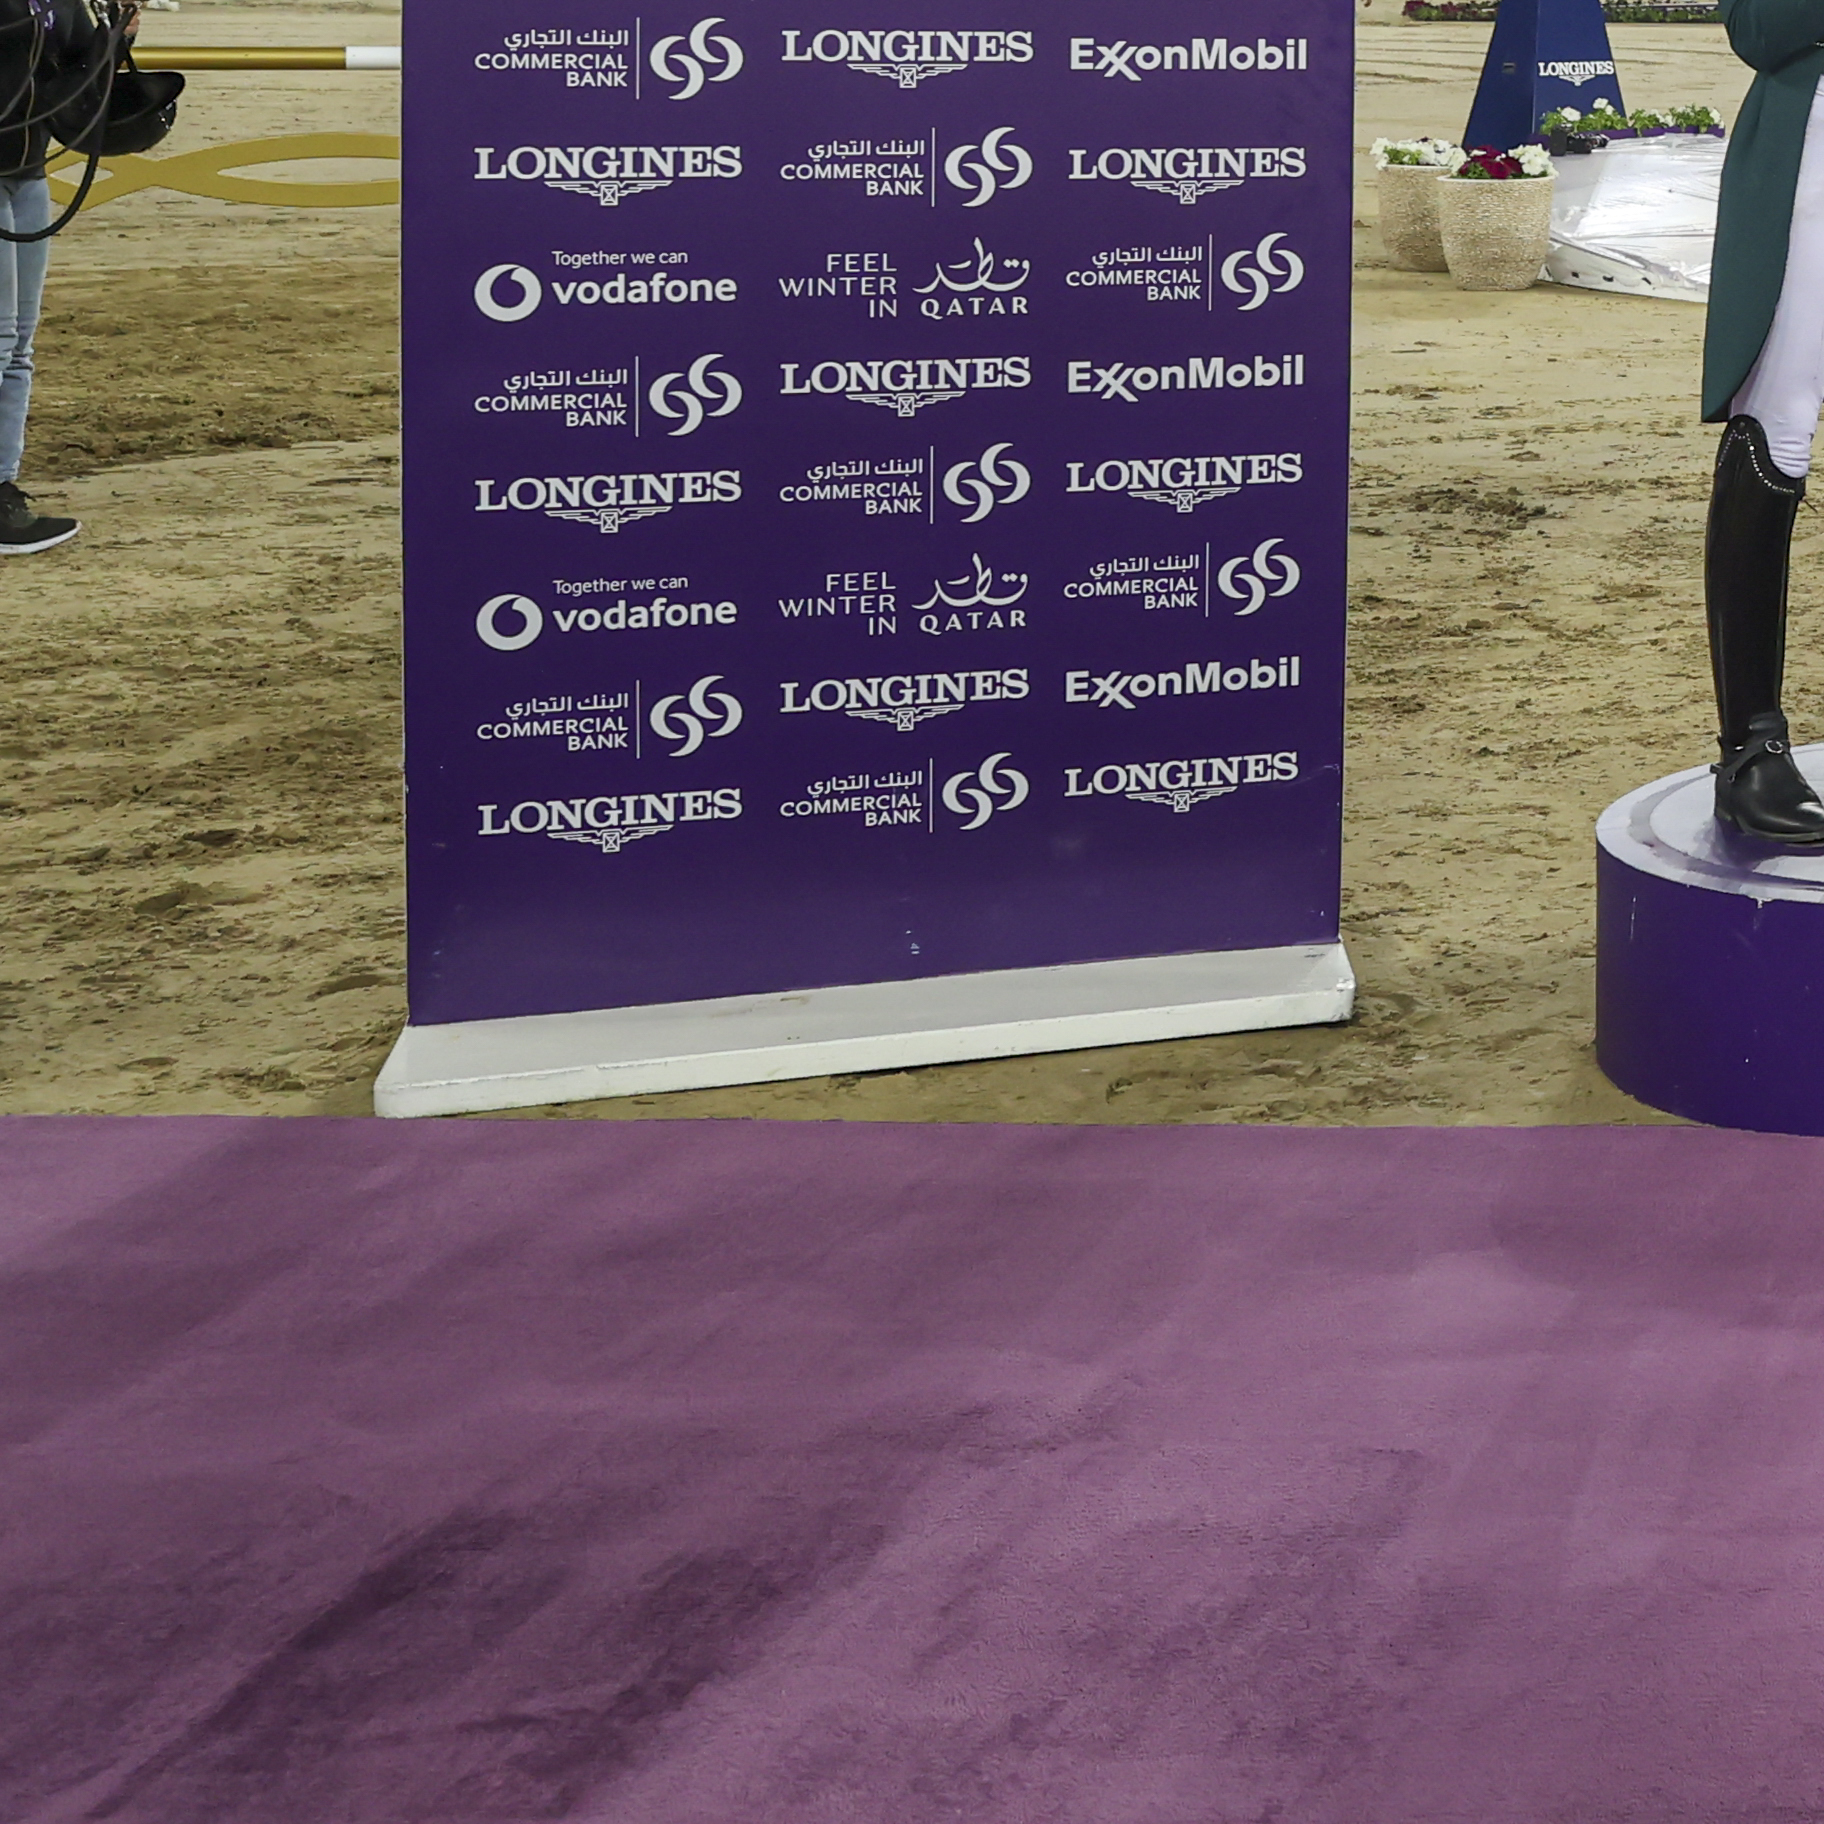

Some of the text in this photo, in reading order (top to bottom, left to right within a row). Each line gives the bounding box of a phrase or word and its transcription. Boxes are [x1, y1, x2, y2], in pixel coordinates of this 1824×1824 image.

[1538, 61, 1614, 76] LONGINES
[1090, 554, 1199, 580] البنك التجاري
[553, 577, 688, 597] Together we can
[827, 572, 896, 592] FEEL
[912, 553, 1028, 609] قطر
[1064, 577, 1198, 598] COMMERCIAL
[778, 594, 896, 617] WINTER
[1145, 592, 1198, 609] BANK
[552, 597, 737, 632] vodafone
[869, 616, 896, 635] IN
[920, 610, 1026, 635] QATAR
[478, 788, 742, 836] LONGINES
